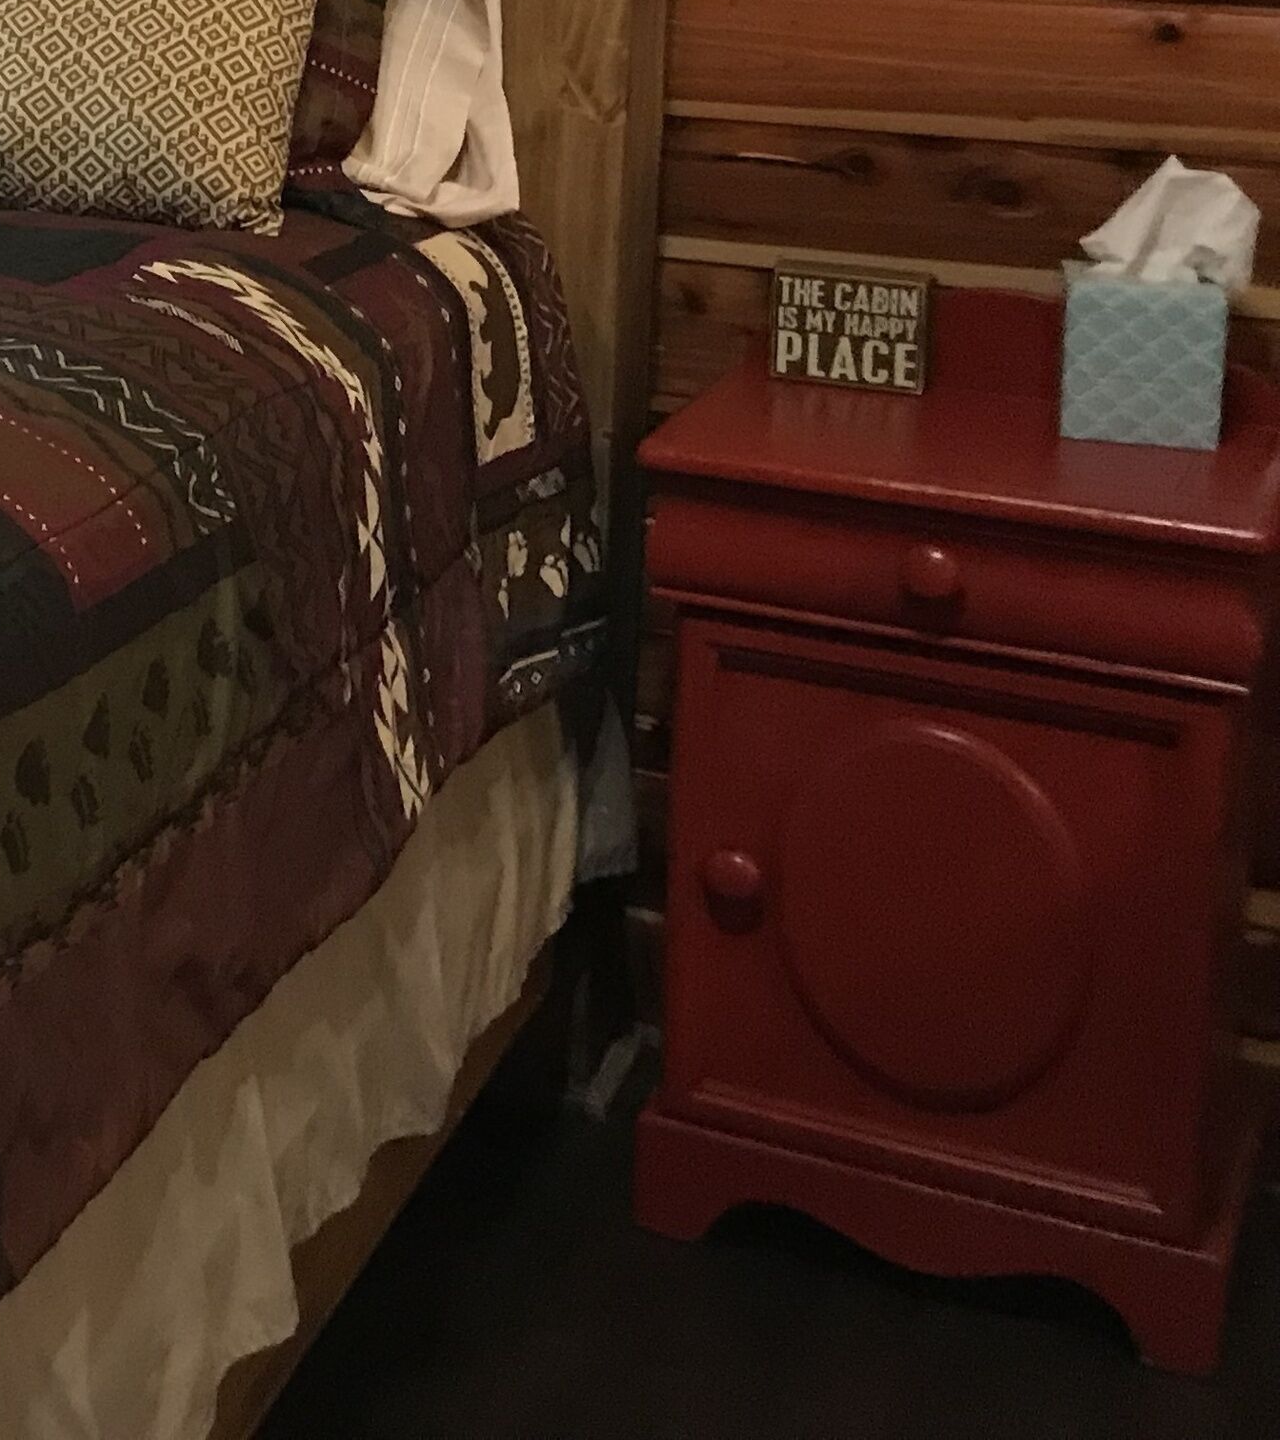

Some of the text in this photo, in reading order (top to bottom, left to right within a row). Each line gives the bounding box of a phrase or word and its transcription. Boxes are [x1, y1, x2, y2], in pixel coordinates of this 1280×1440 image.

[778, 275, 919, 317] THE CABIN
[778, 305, 918, 341] IS MY HAPPY
[776, 329, 919, 389] PLACE
